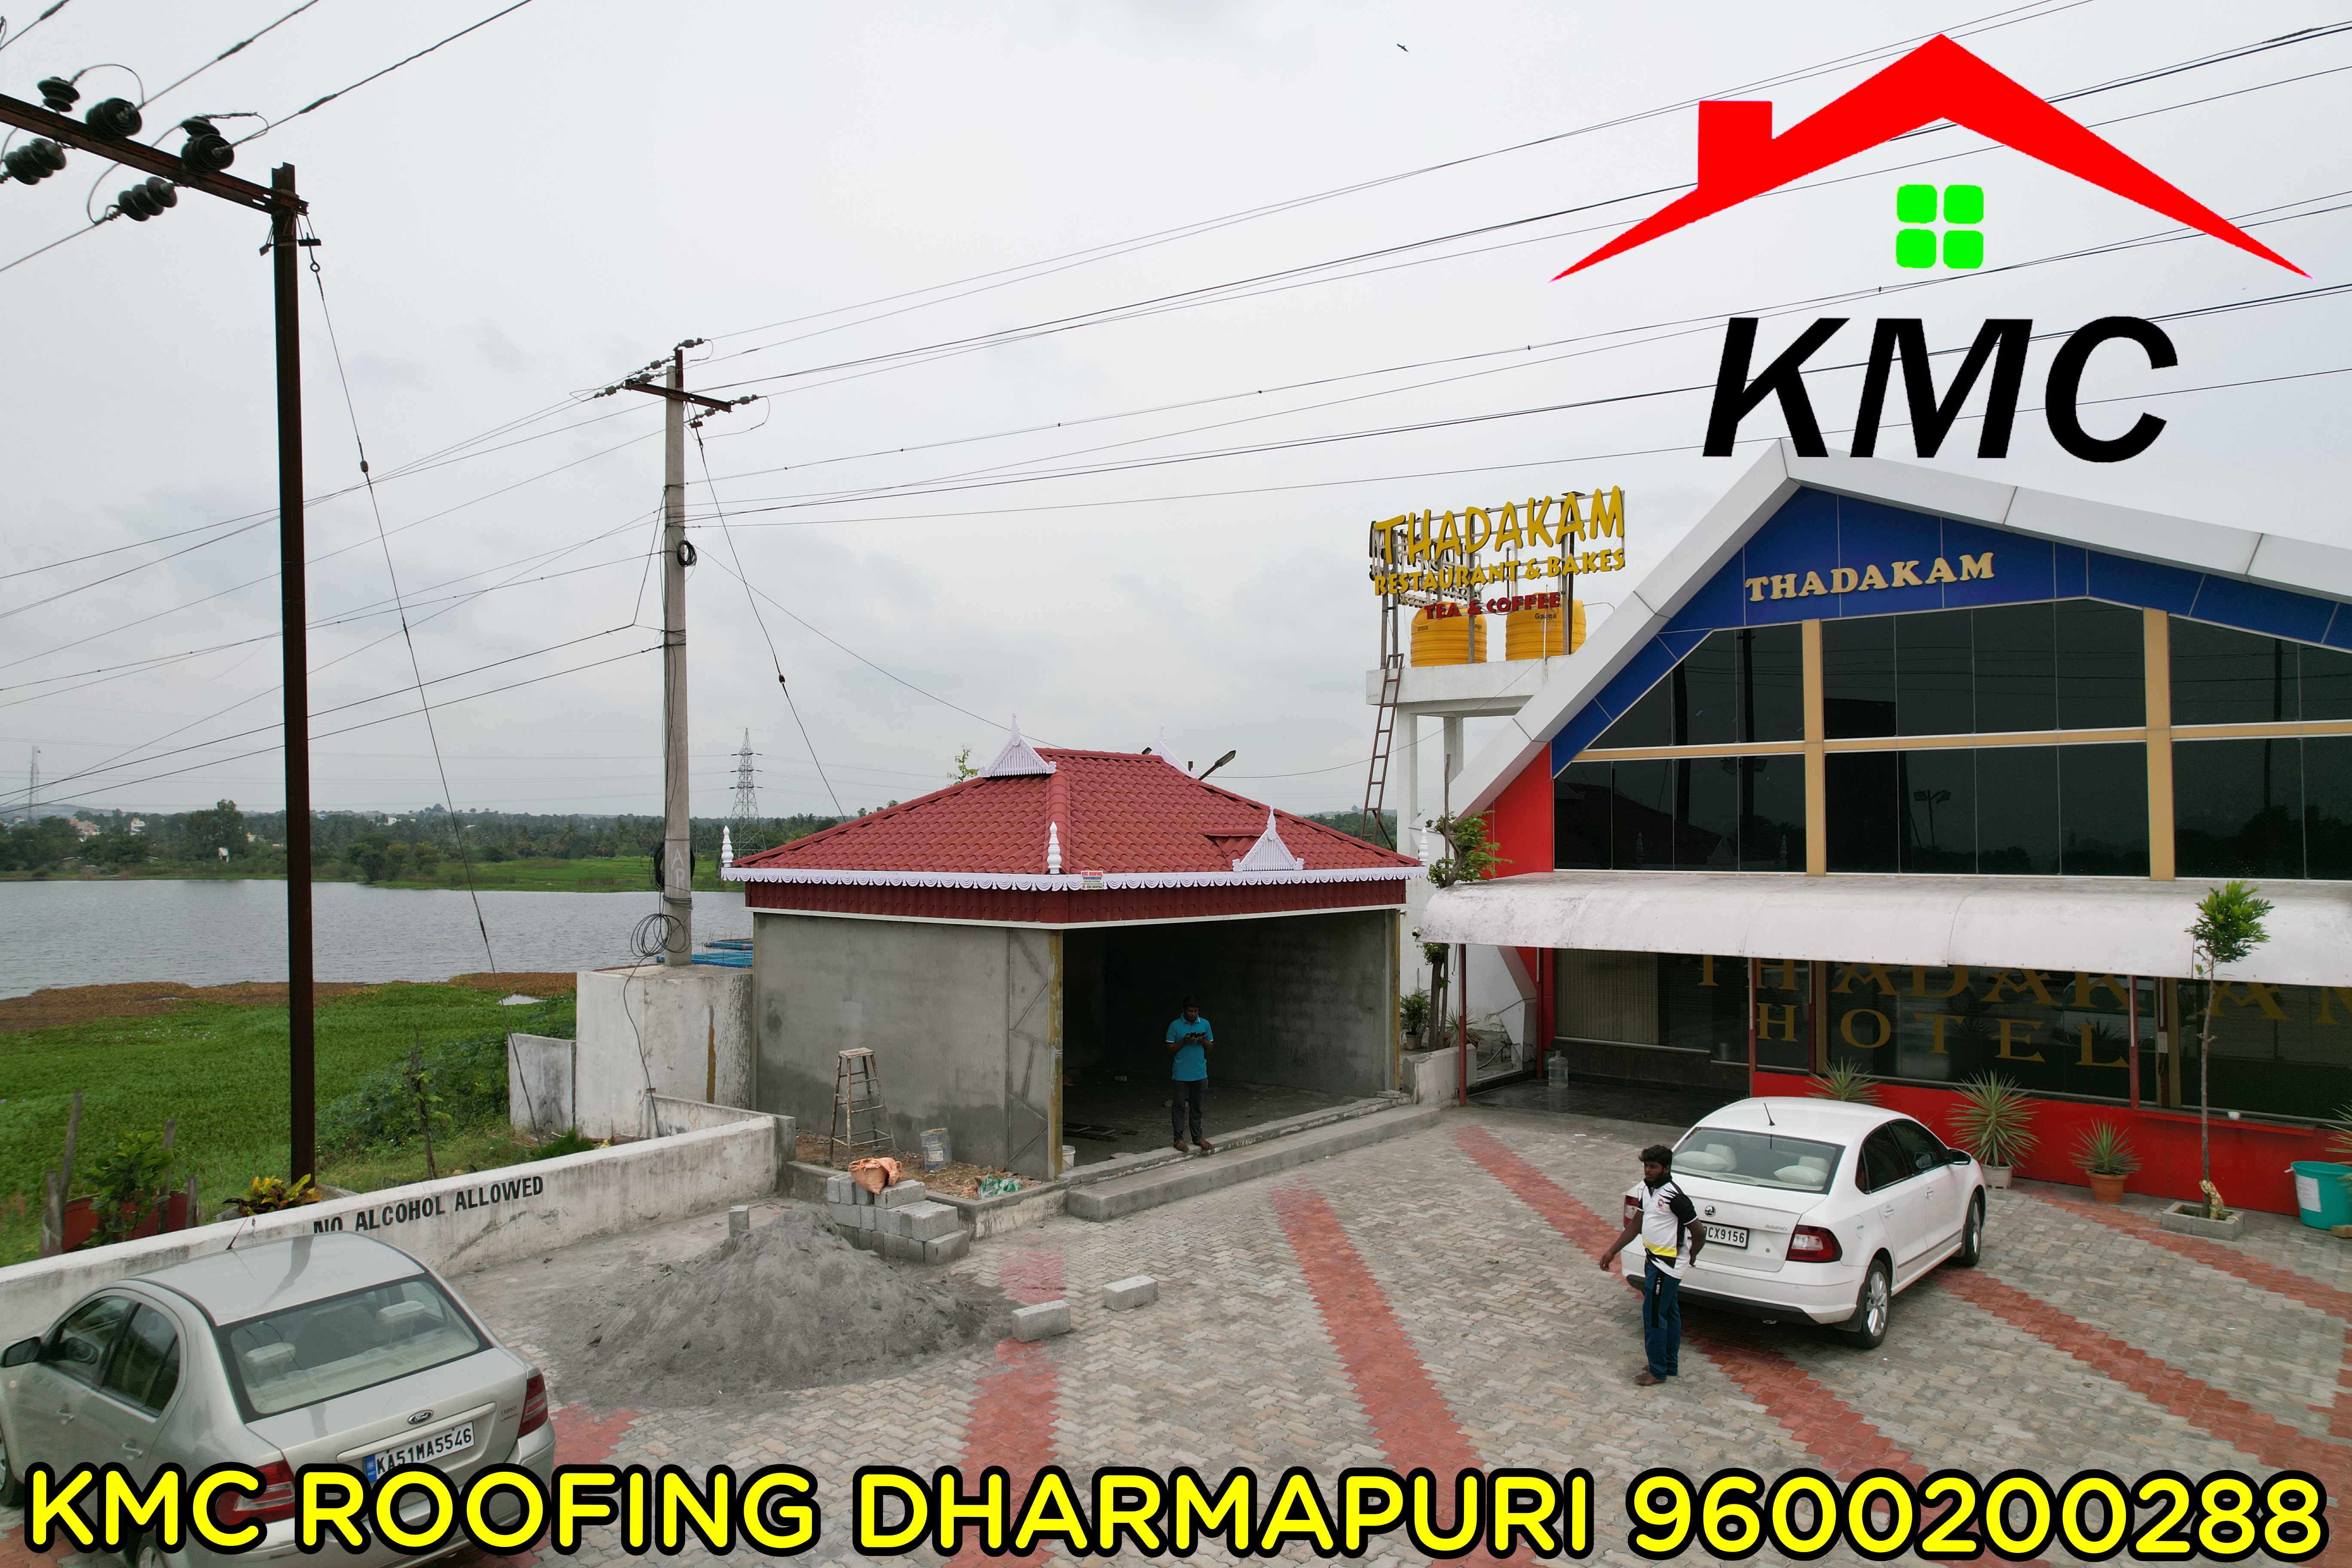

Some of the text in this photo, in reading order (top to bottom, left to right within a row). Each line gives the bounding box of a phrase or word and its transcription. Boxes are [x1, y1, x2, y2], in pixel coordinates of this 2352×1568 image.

[1374, 485, 1625, 564] THADAKAM
[1375, 548, 1625, 596] RESTAURANT & BAKES
[1745, 552, 1995, 601] THADAKAM
[1424, 592, 1559, 620] TEA & COFFEE
[1756, 1002, 2130, 1068] HOTEL
[355, 1195, 446, 1232] ALCOHOL
[454, 1176, 544, 1212] ALLOWED
[377, 1427, 472, 1475] KA51MA5546
